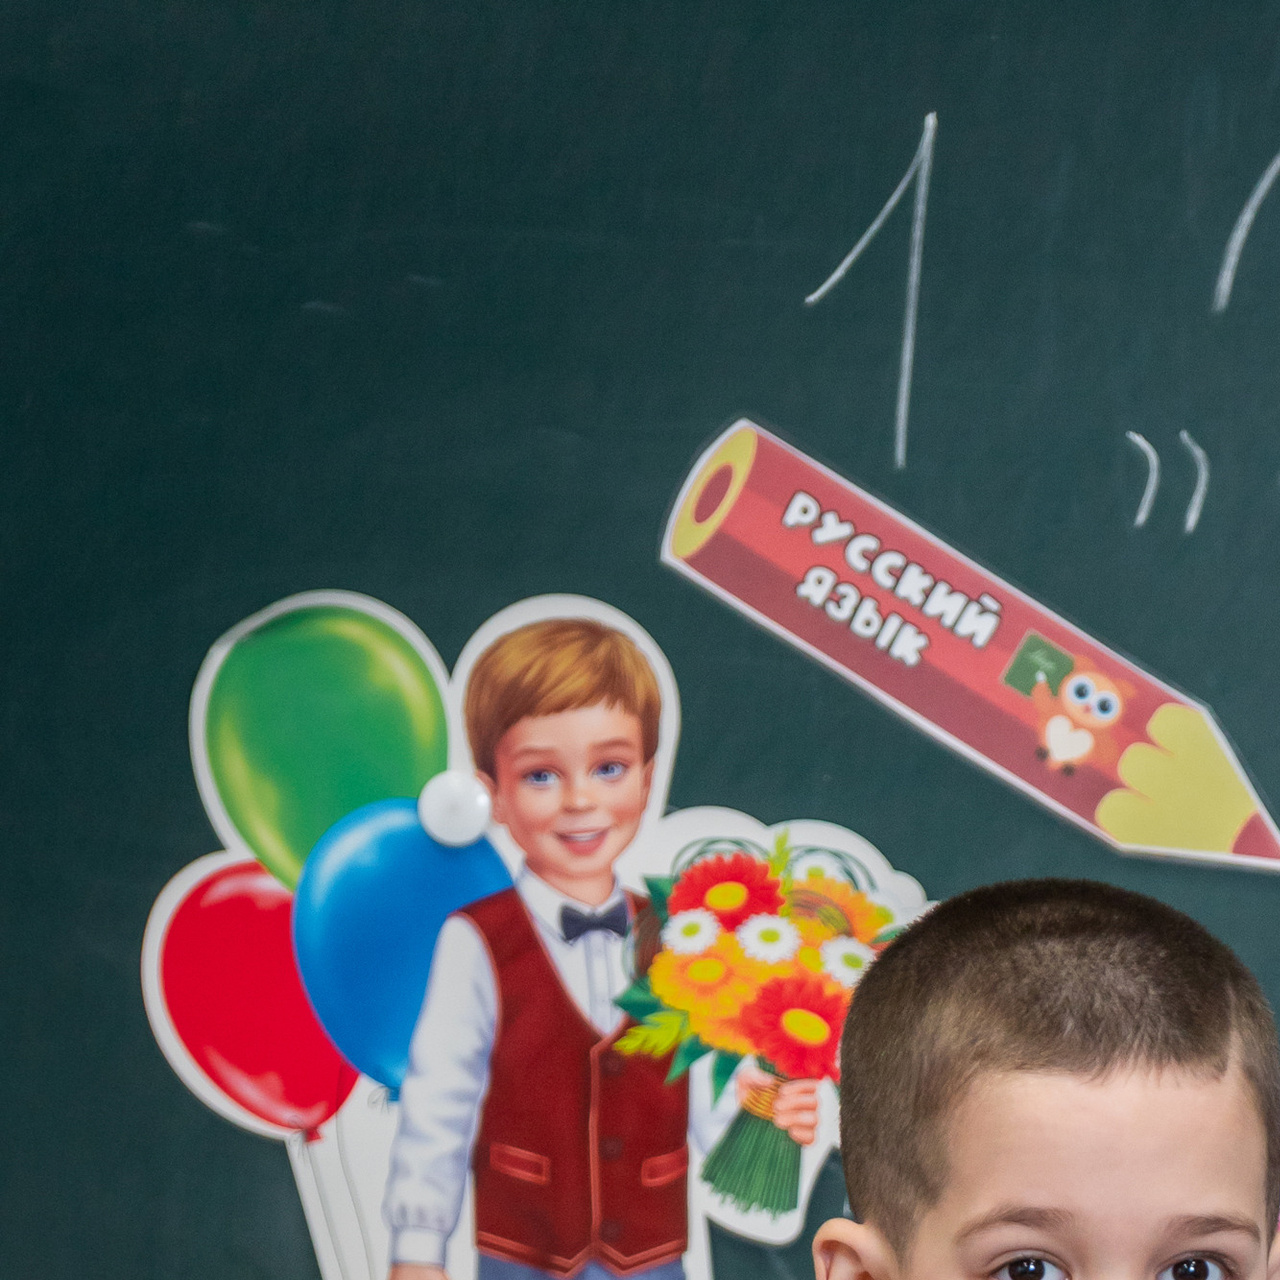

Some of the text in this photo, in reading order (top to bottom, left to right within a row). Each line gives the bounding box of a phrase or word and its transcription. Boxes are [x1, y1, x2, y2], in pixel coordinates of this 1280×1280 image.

[805, 112, 937, 468] 1
[781, 489, 1003, 649] РУССКИЙ
[796, 565, 930, 667] ЯЗЫК
